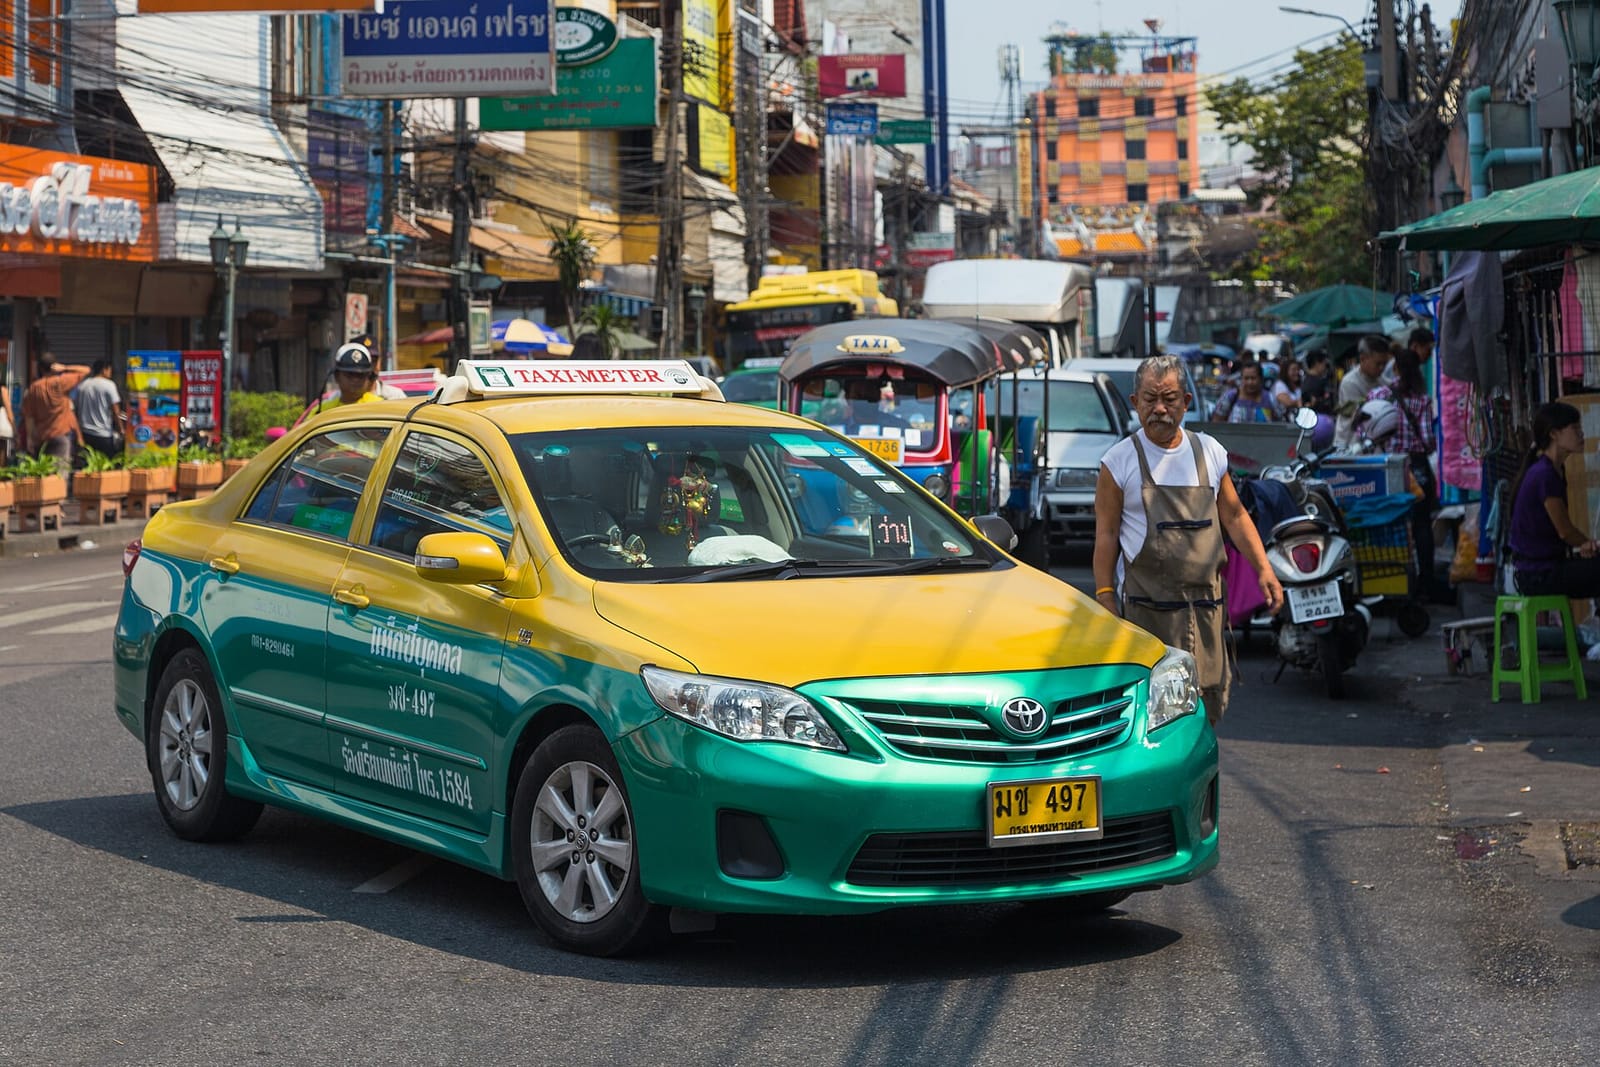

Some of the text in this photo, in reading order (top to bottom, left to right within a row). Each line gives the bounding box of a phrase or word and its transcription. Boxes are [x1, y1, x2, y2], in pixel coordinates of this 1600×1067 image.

[408, 4, 478, 39] แอนด์
[485, 4, 546, 38] เฟรช
[853, 338, 888, 348] TAXI
[184, 359, 219, 370] PHOTO
[185, 371, 217, 382] VISA
[514, 369, 665, 383] TAXI-METER
[868, 442, 899, 453] 1736
[878, 516, 908, 544] ว่าง
[370, 615, 463, 678] แท็กซี่บุคคล
[388, 682, 436, 718] มช-497
[995, 783, 1087, 818] มช 497
[1009, 820, 1083, 835] กรงเทพมหานคร
